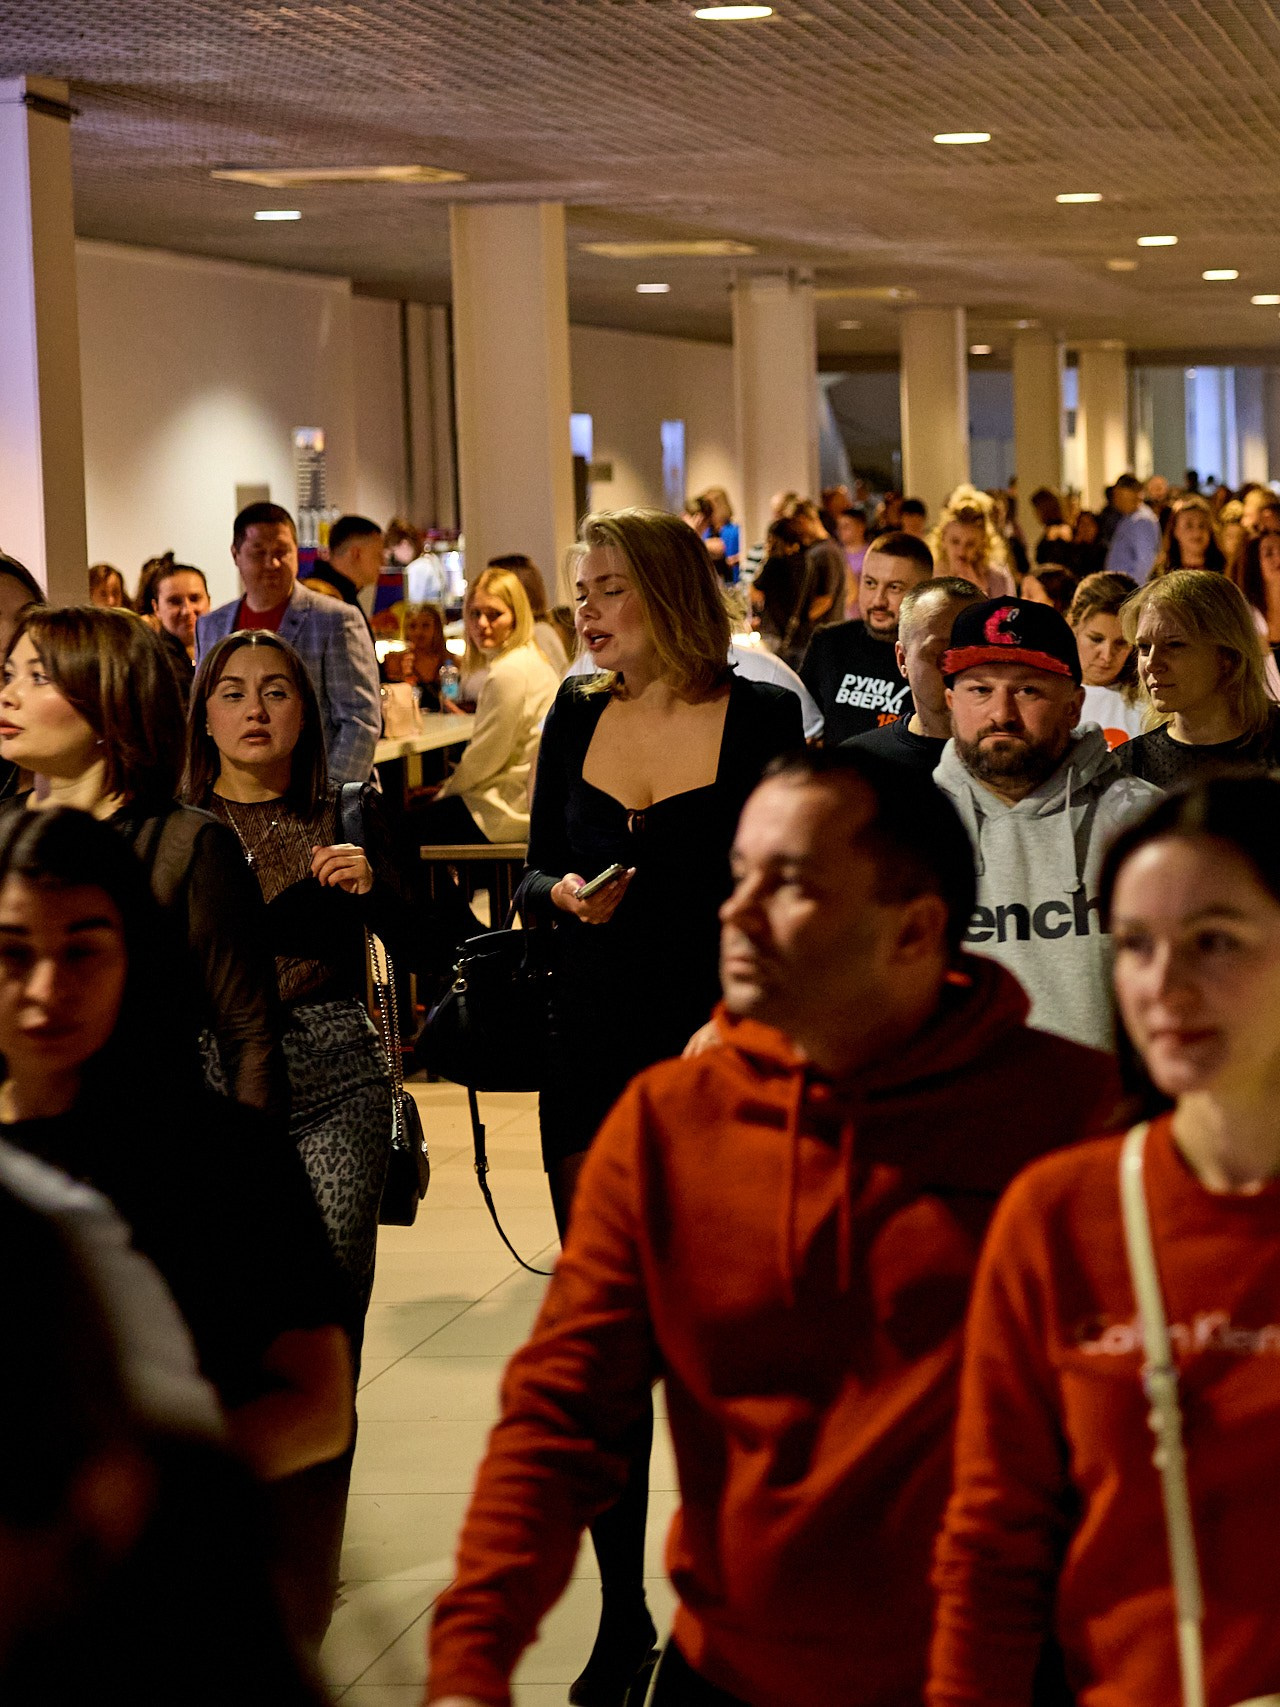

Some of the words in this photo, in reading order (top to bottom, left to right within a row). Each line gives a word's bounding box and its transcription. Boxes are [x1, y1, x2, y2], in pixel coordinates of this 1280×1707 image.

[835, 685, 911, 715] ВВЕРХ!
[841, 673, 895, 697] РУКИ
[962, 882, 1113, 943] ench
